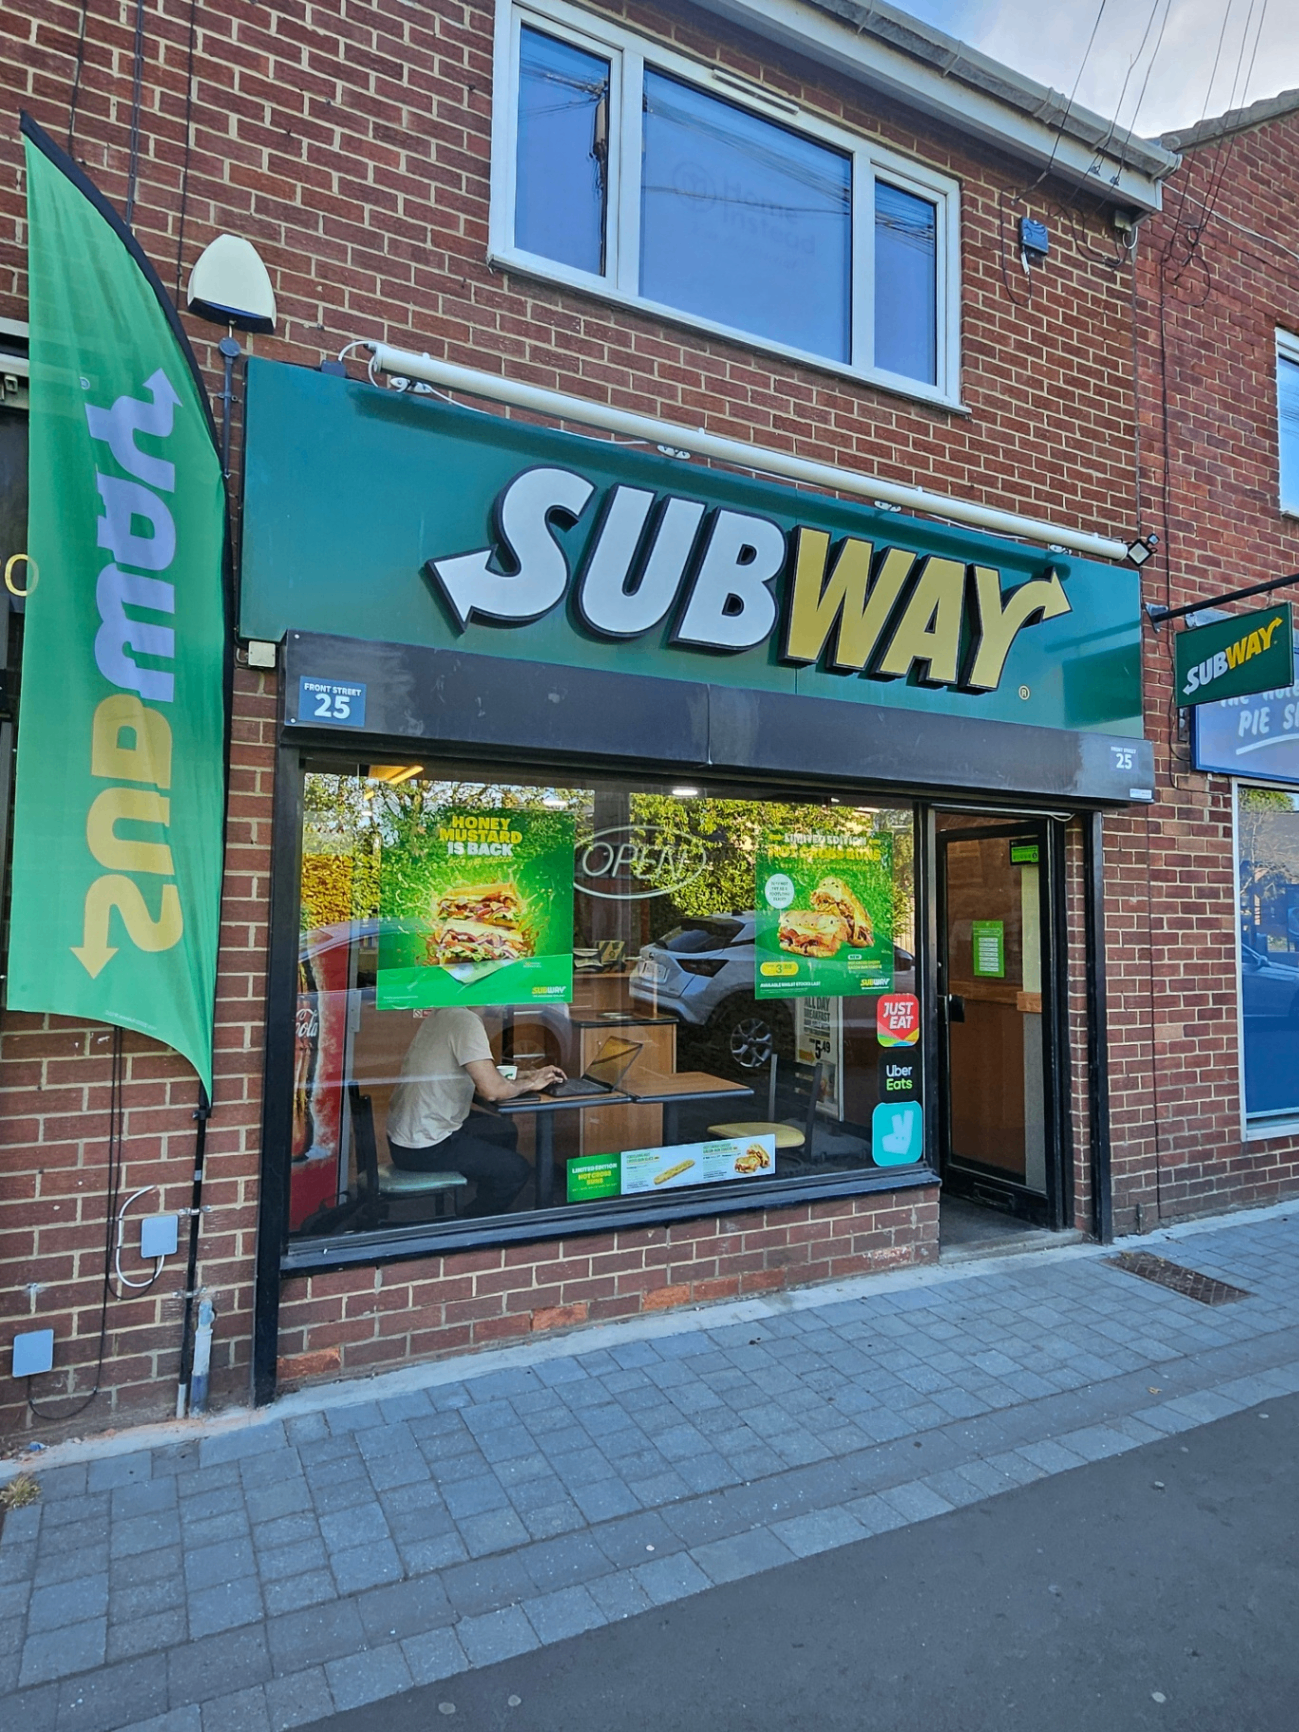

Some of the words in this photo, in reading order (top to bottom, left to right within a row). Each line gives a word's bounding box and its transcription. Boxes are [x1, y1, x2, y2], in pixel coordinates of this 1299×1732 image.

[430, 466, 1072, 692] SUBWAY
[1183, 617, 1283, 695] SUBWAY
[304, 682, 331, 692] FRONT
[332, 686, 362, 696] STREET
[314, 693, 350, 719] 25
[1238, 706, 1271, 738] PIE
[1115, 752, 1133, 770] 25
[451, 815, 511, 831] HONEY
[439, 828, 523, 844] MUSTARD
[447, 842, 465, 855] IS
[467, 842, 514, 857] BACK
[582, 841, 688, 880] OPEN
[532, 986, 566, 994] SUBWAY
[861, 978, 890, 986] SUBWAY
[883, 1002, 914, 1018] JUST
[889, 1016, 914, 1029] EAT
[886, 1065, 912, 1077] Uber
[886, 1078, 913, 1091] Eats
